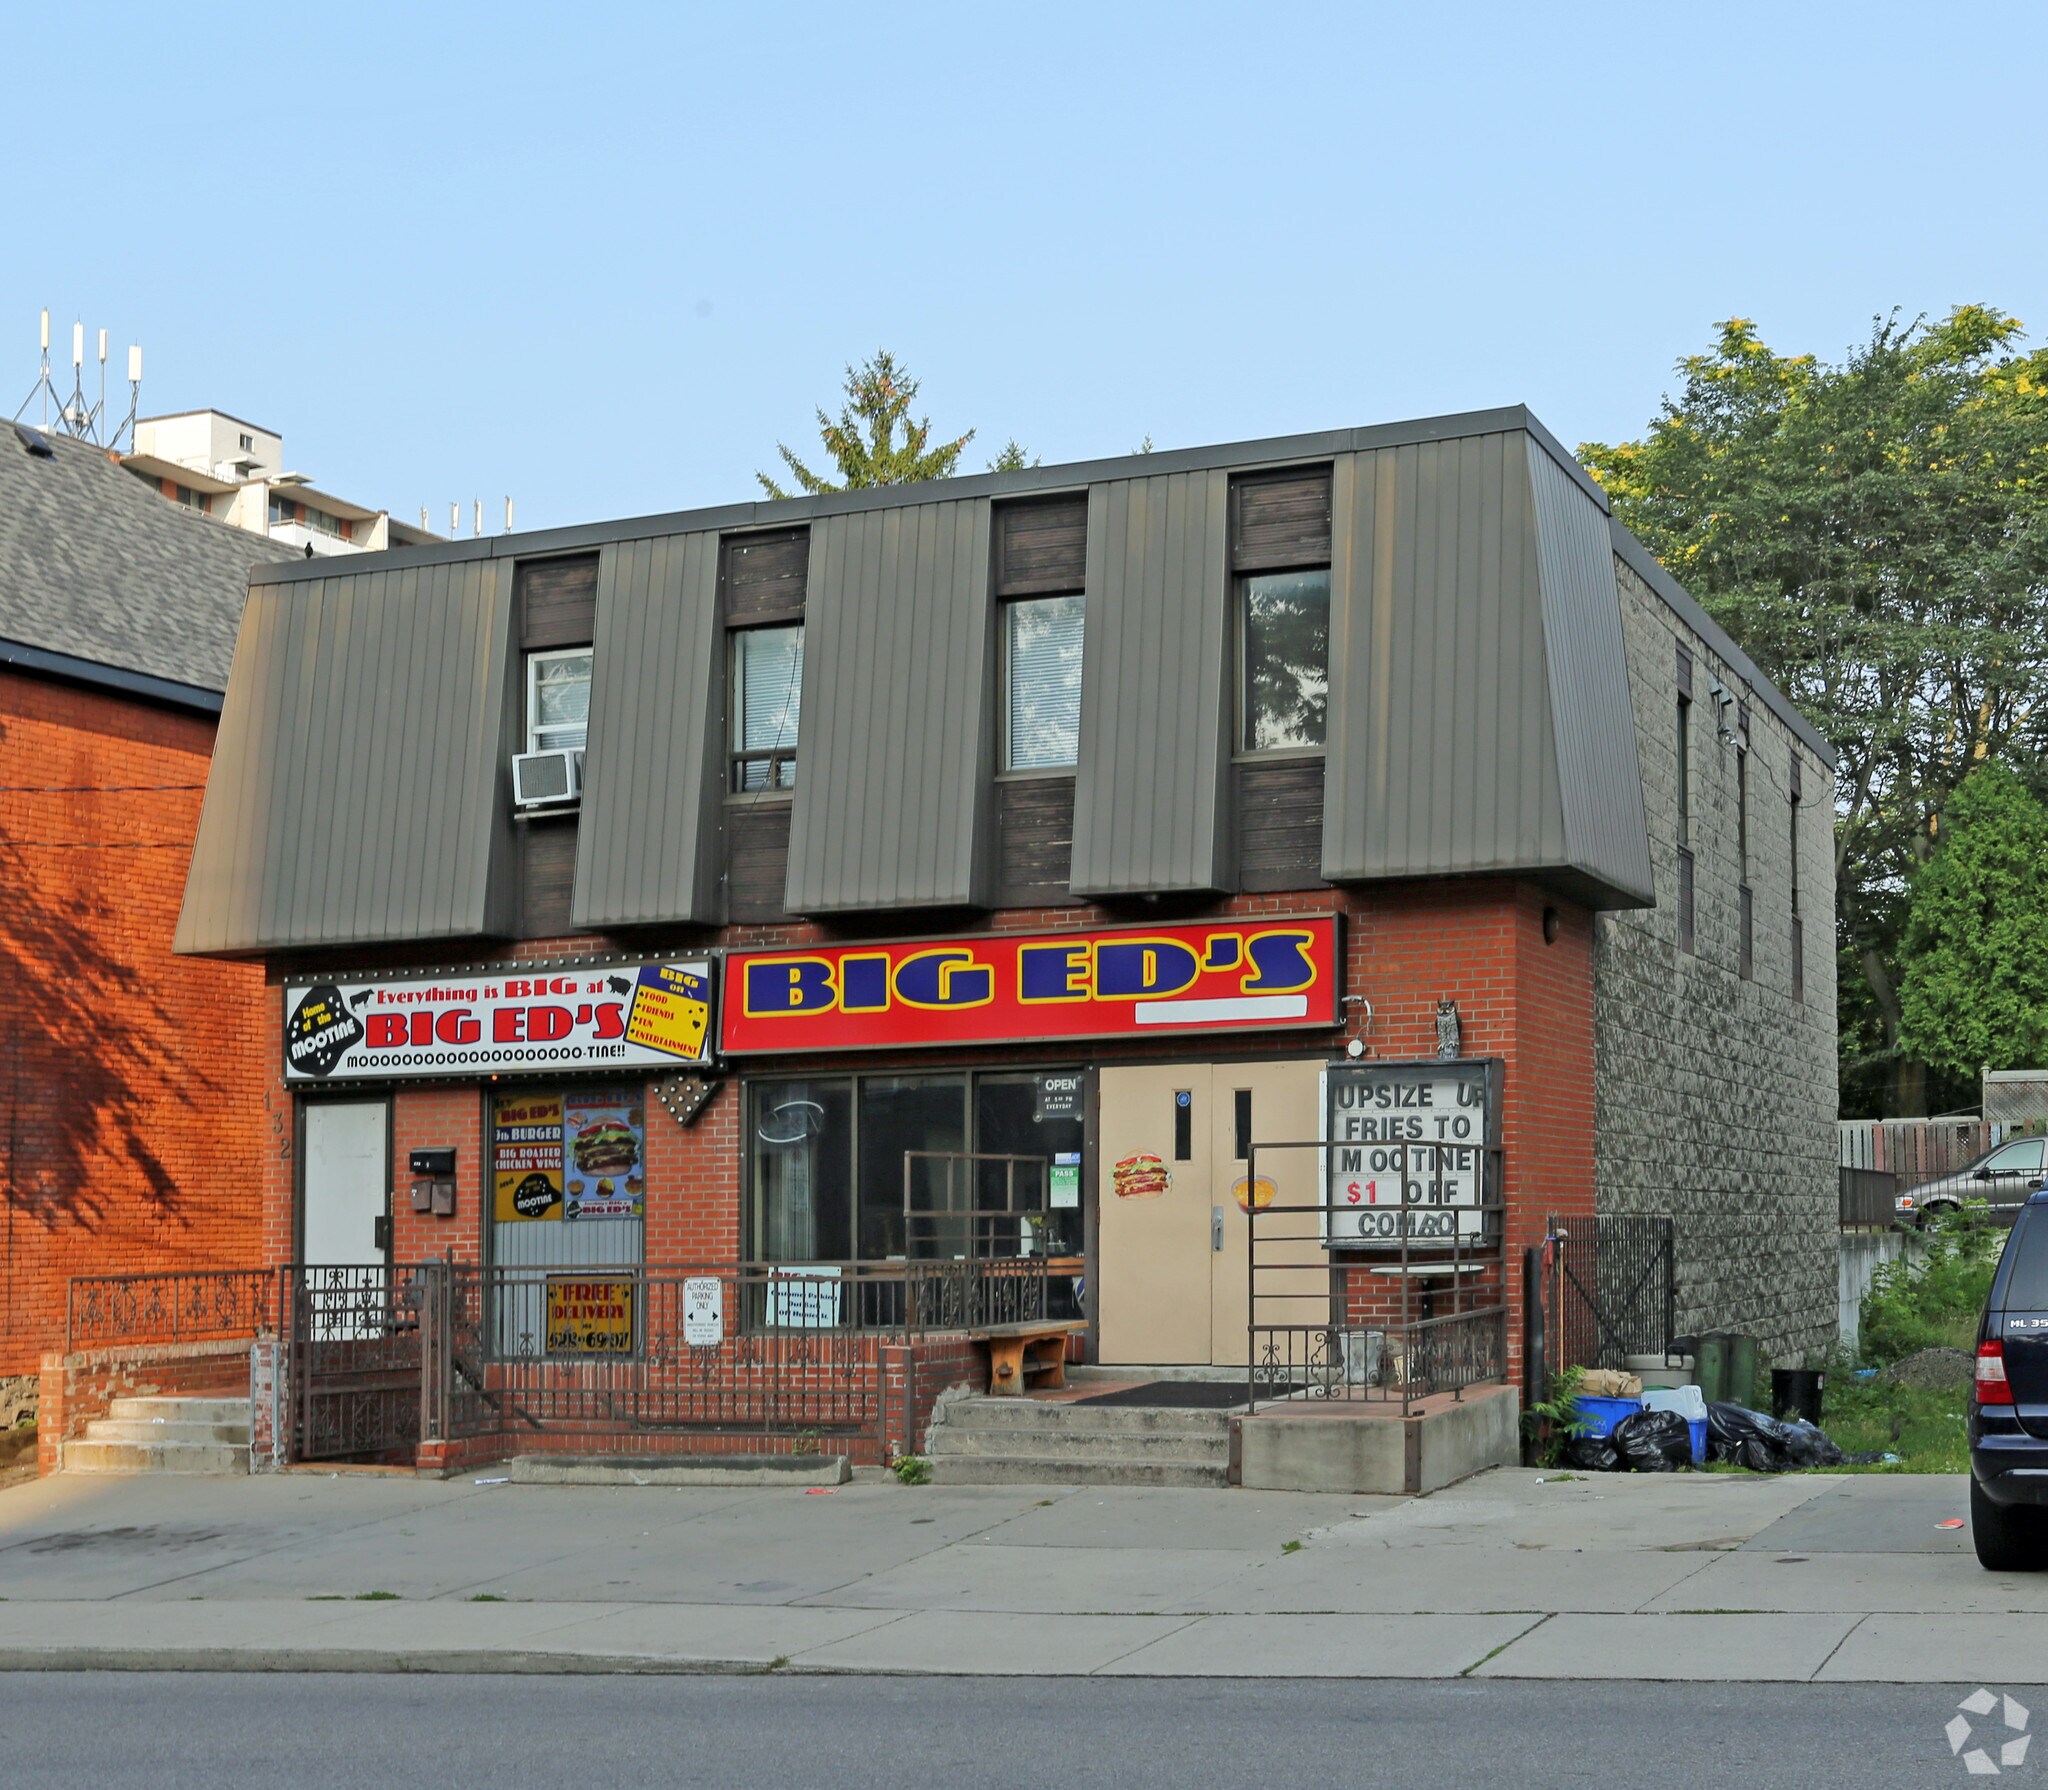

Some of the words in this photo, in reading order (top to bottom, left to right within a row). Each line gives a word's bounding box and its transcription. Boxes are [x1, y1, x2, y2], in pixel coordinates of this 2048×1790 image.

[659, 967, 699, 988] BIG
[744, 948, 994, 1018] BIG
[1016, 930, 1317, 1004] ED'S
[377, 987, 478, 1005] Everything
[484, 985, 498, 999] is
[505, 977, 577, 998] BIG
[586, 979, 604, 993] at
[669, 983, 685, 993] on
[644, 991, 668, 1005] FOOD
[302, 1003, 326, 1019] Home
[641, 1004, 675, 1020] FRIENDS
[303, 1018, 311, 1032] of
[317, 1012, 332, 1025] the
[365, 1008, 482, 1048] BIG
[492, 1003, 625, 1043] ED'S
[638, 1017, 654, 1029] FUN
[635, 1029, 698, 1055] ENTERTAINMENT
[1045, 1078, 1077, 1091] OPEN
[1337, 1083, 1433, 1109] UPSIZE
[501, 1107, 528, 1123] BIG
[529, 1103, 560, 1119] ED'S
[511, 1126, 561, 1141] BURGER
[1345, 1115, 1423, 1140] FRIES
[1434, 1115, 1471, 1139] TO
[500, 1148, 517, 1159] BIG
[519, 1147, 561, 1158] ROASTER
[495, 1158, 533, 1170] CHICKEN
[1055, 1170, 1074, 1178] PASS
[1347, 1180, 1376, 1204] $1
[1358, 1212, 1455, 1237] COMBO
[563, 1283, 616, 1301] FREE
[687, 1282, 719, 1291] AUTHORIZED
[691, 1291, 714, 1301] PARKING
[552, 1305, 624, 1319] DELIVERY
[696, 1301, 709, 1310] ONLY
[2010, 1319, 2028, 1328] ML
